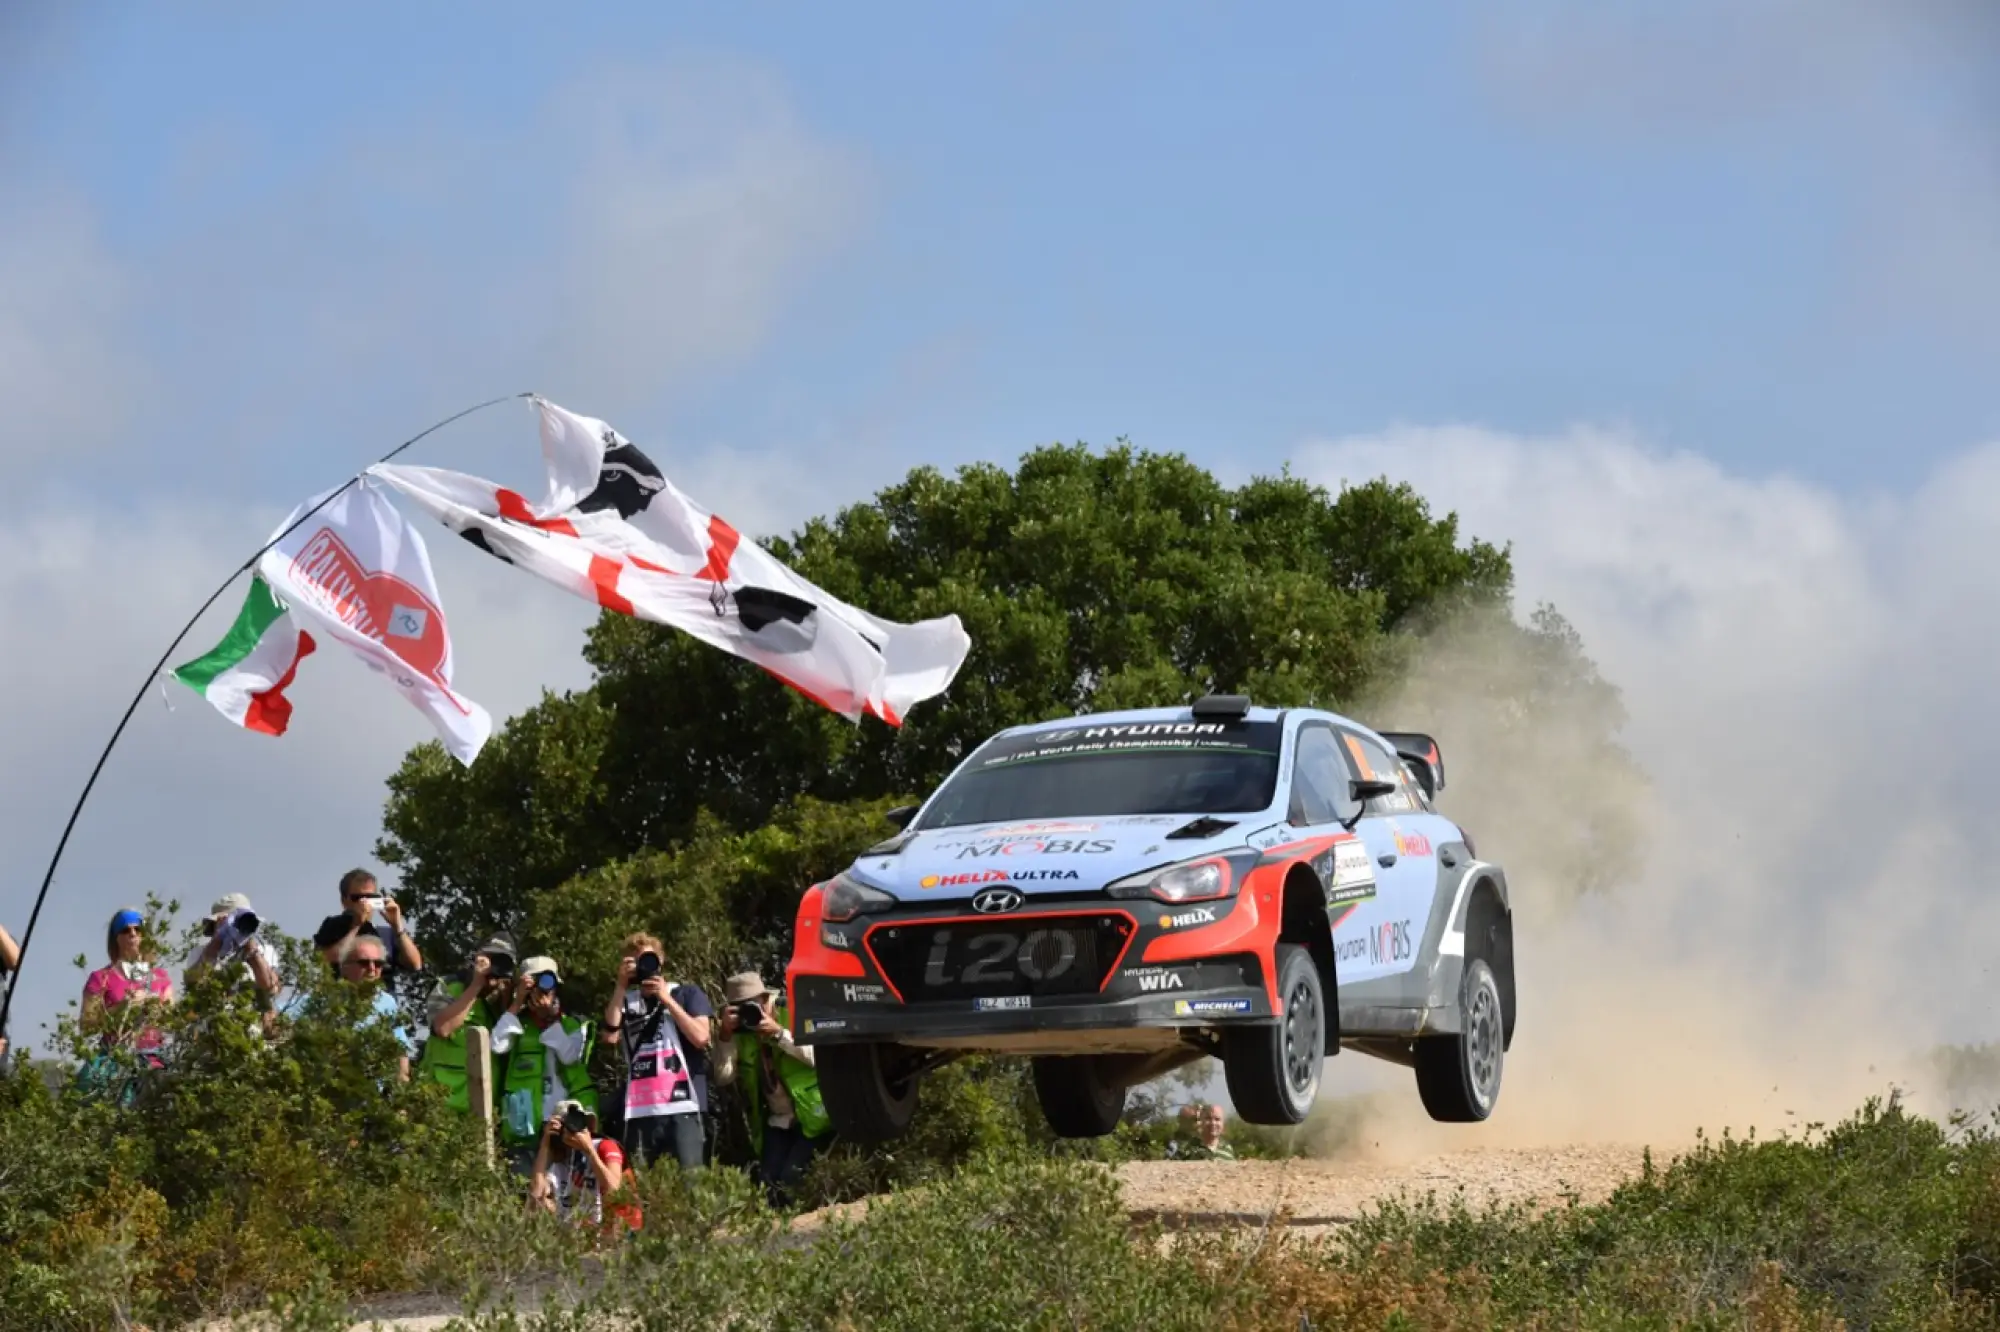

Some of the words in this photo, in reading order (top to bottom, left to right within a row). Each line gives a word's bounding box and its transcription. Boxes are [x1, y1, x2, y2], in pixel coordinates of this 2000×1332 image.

[296, 536, 356, 606] RALLY
[1085, 722, 1226, 738] HYUNDAI
[1040, 744, 1074, 756] World
[1077, 742, 1106, 752] Rally
[1108, 738, 1193, 749] Championship
[954, 838, 1117, 860] MOBIS
[940, 868, 1010, 887] HELIX
[1012, 868, 1080, 881] ULTRA
[1172, 906, 1216, 928] HELIX
[1369, 919, 1412, 966] MOBIS
[924, 928, 1077, 986] i20
[1138, 972, 1184, 991] WIA
[1193, 1000, 1249, 1011] MICHELIN
